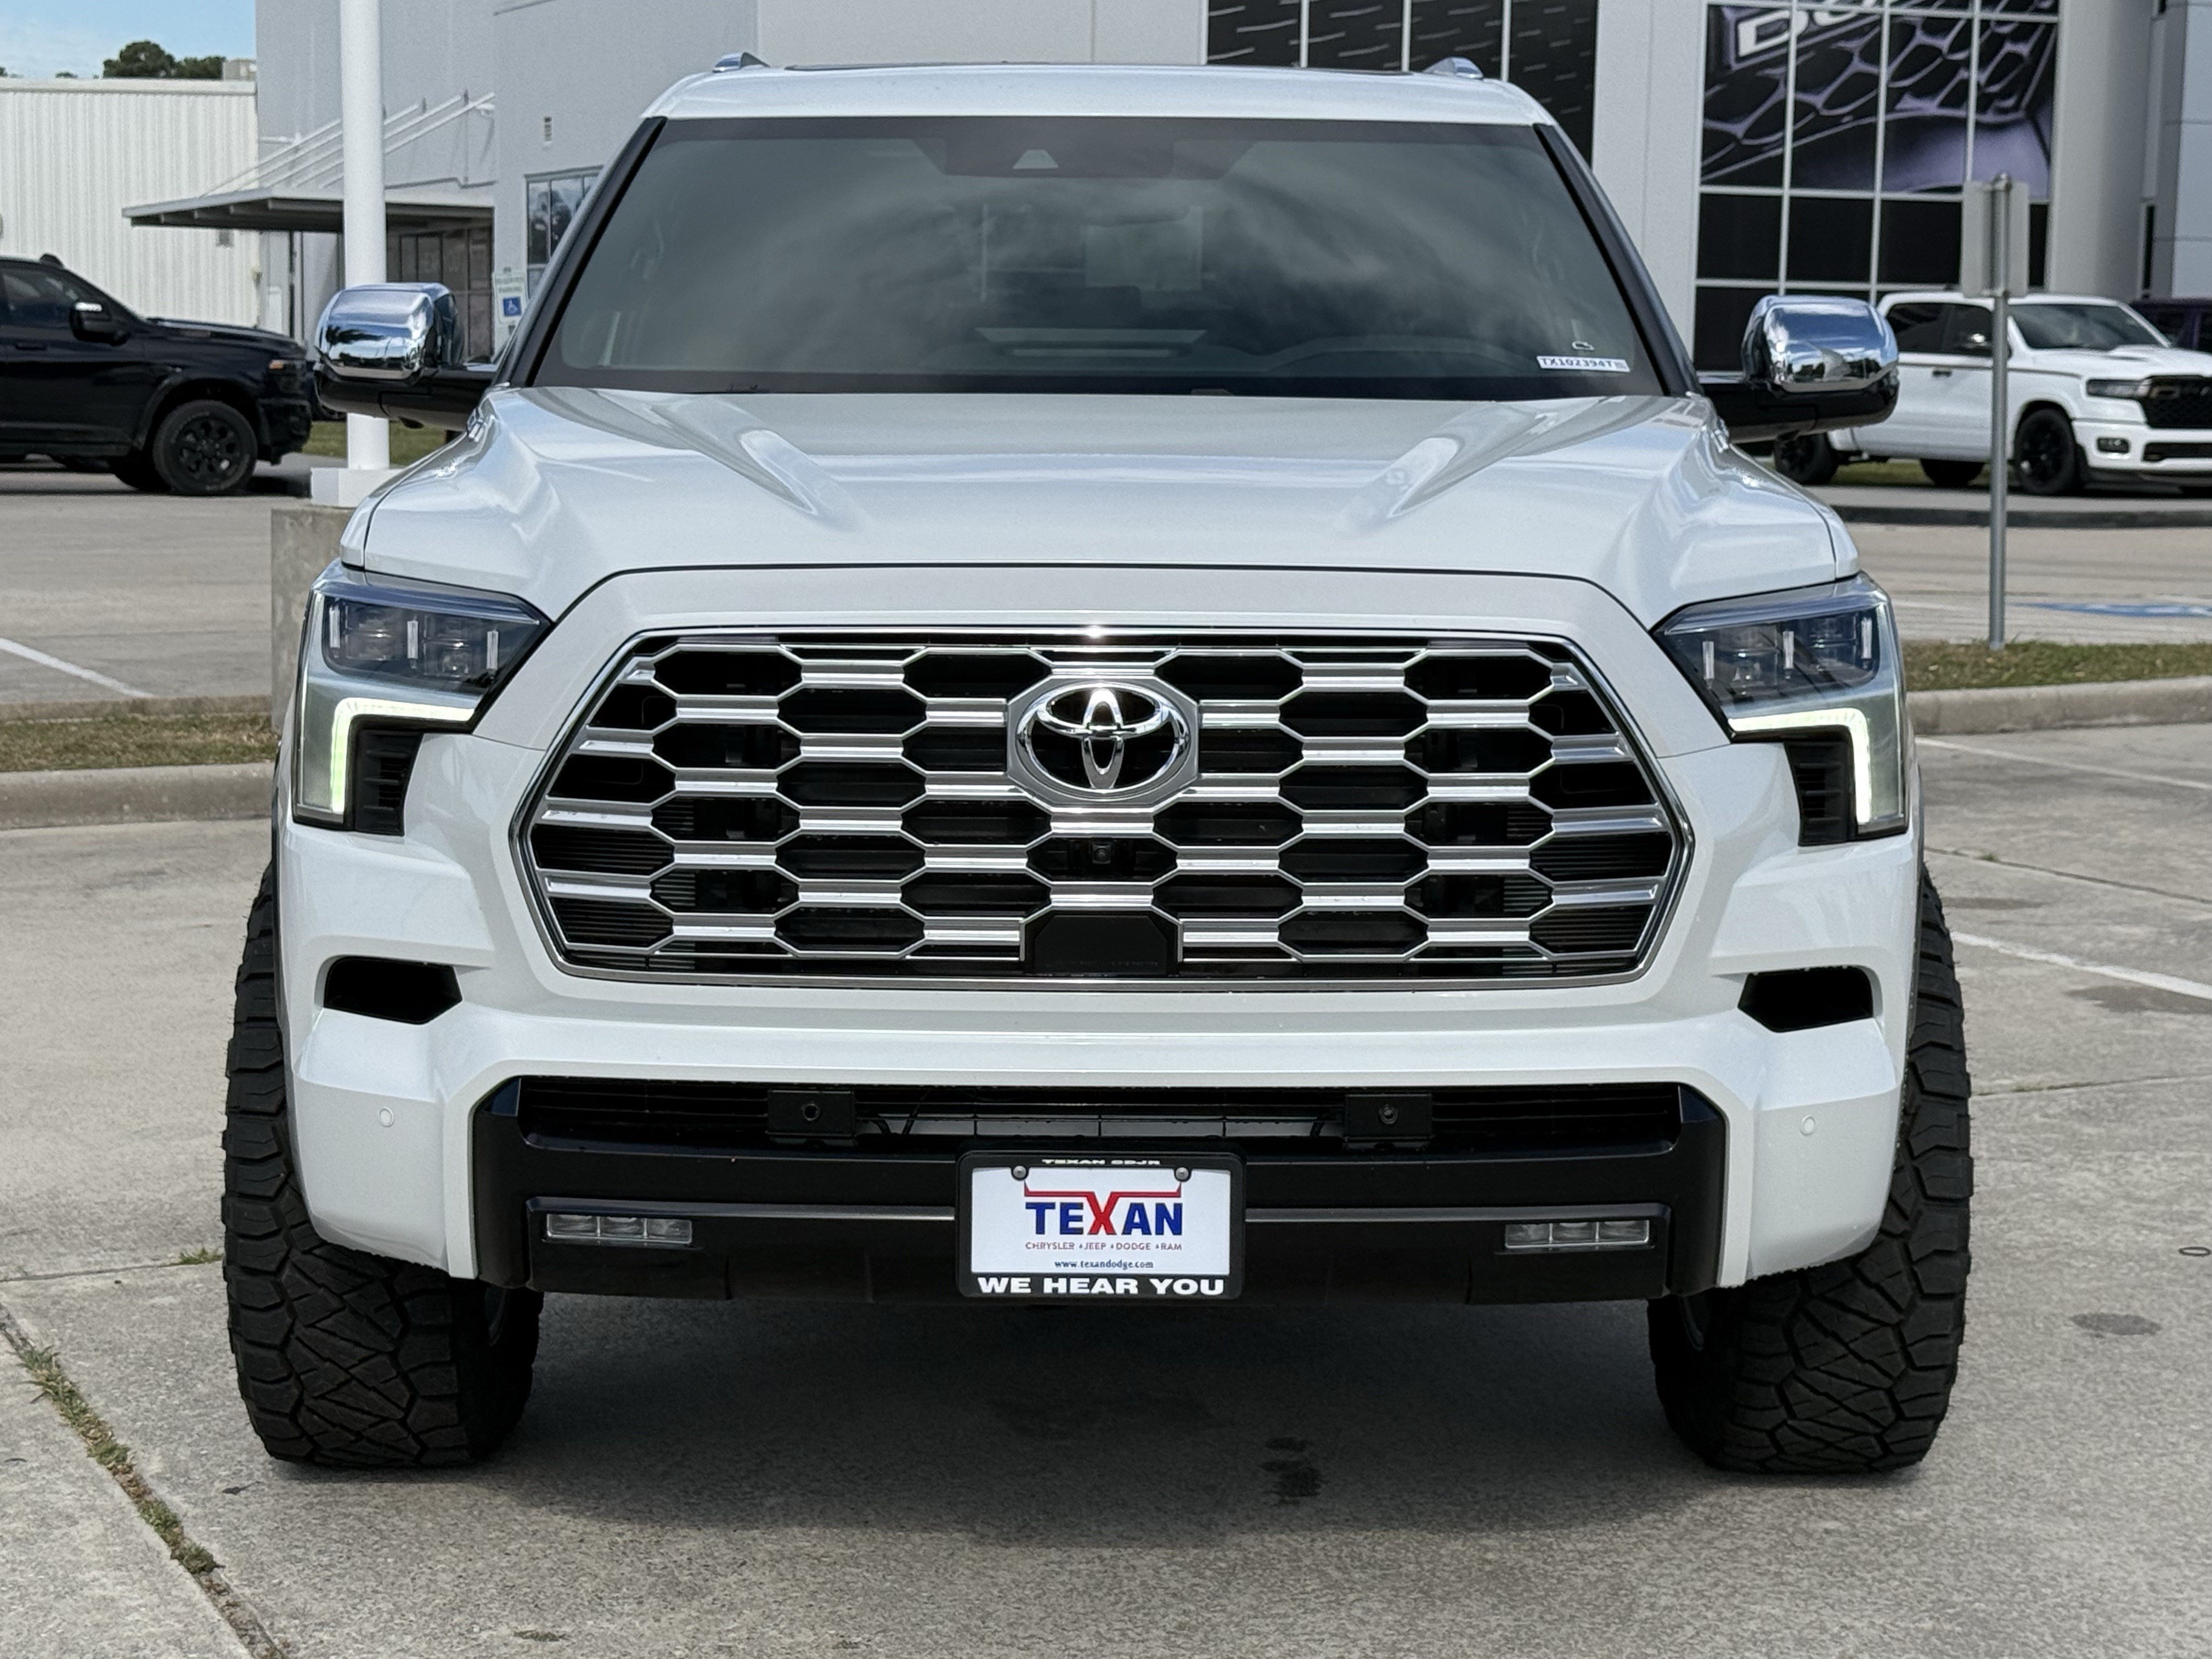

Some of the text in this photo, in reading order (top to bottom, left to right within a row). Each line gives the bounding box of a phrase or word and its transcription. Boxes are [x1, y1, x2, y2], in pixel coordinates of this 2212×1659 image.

[1025, 1192, 1183, 1236] TEXAN
[1025, 1242, 1183, 1251] CHRYSLER JEEP DODGE RAM
[1054, 1259, 1154, 1271] www.texandodge.com
[977, 1277, 1225, 1296] WE HEAR YOU
